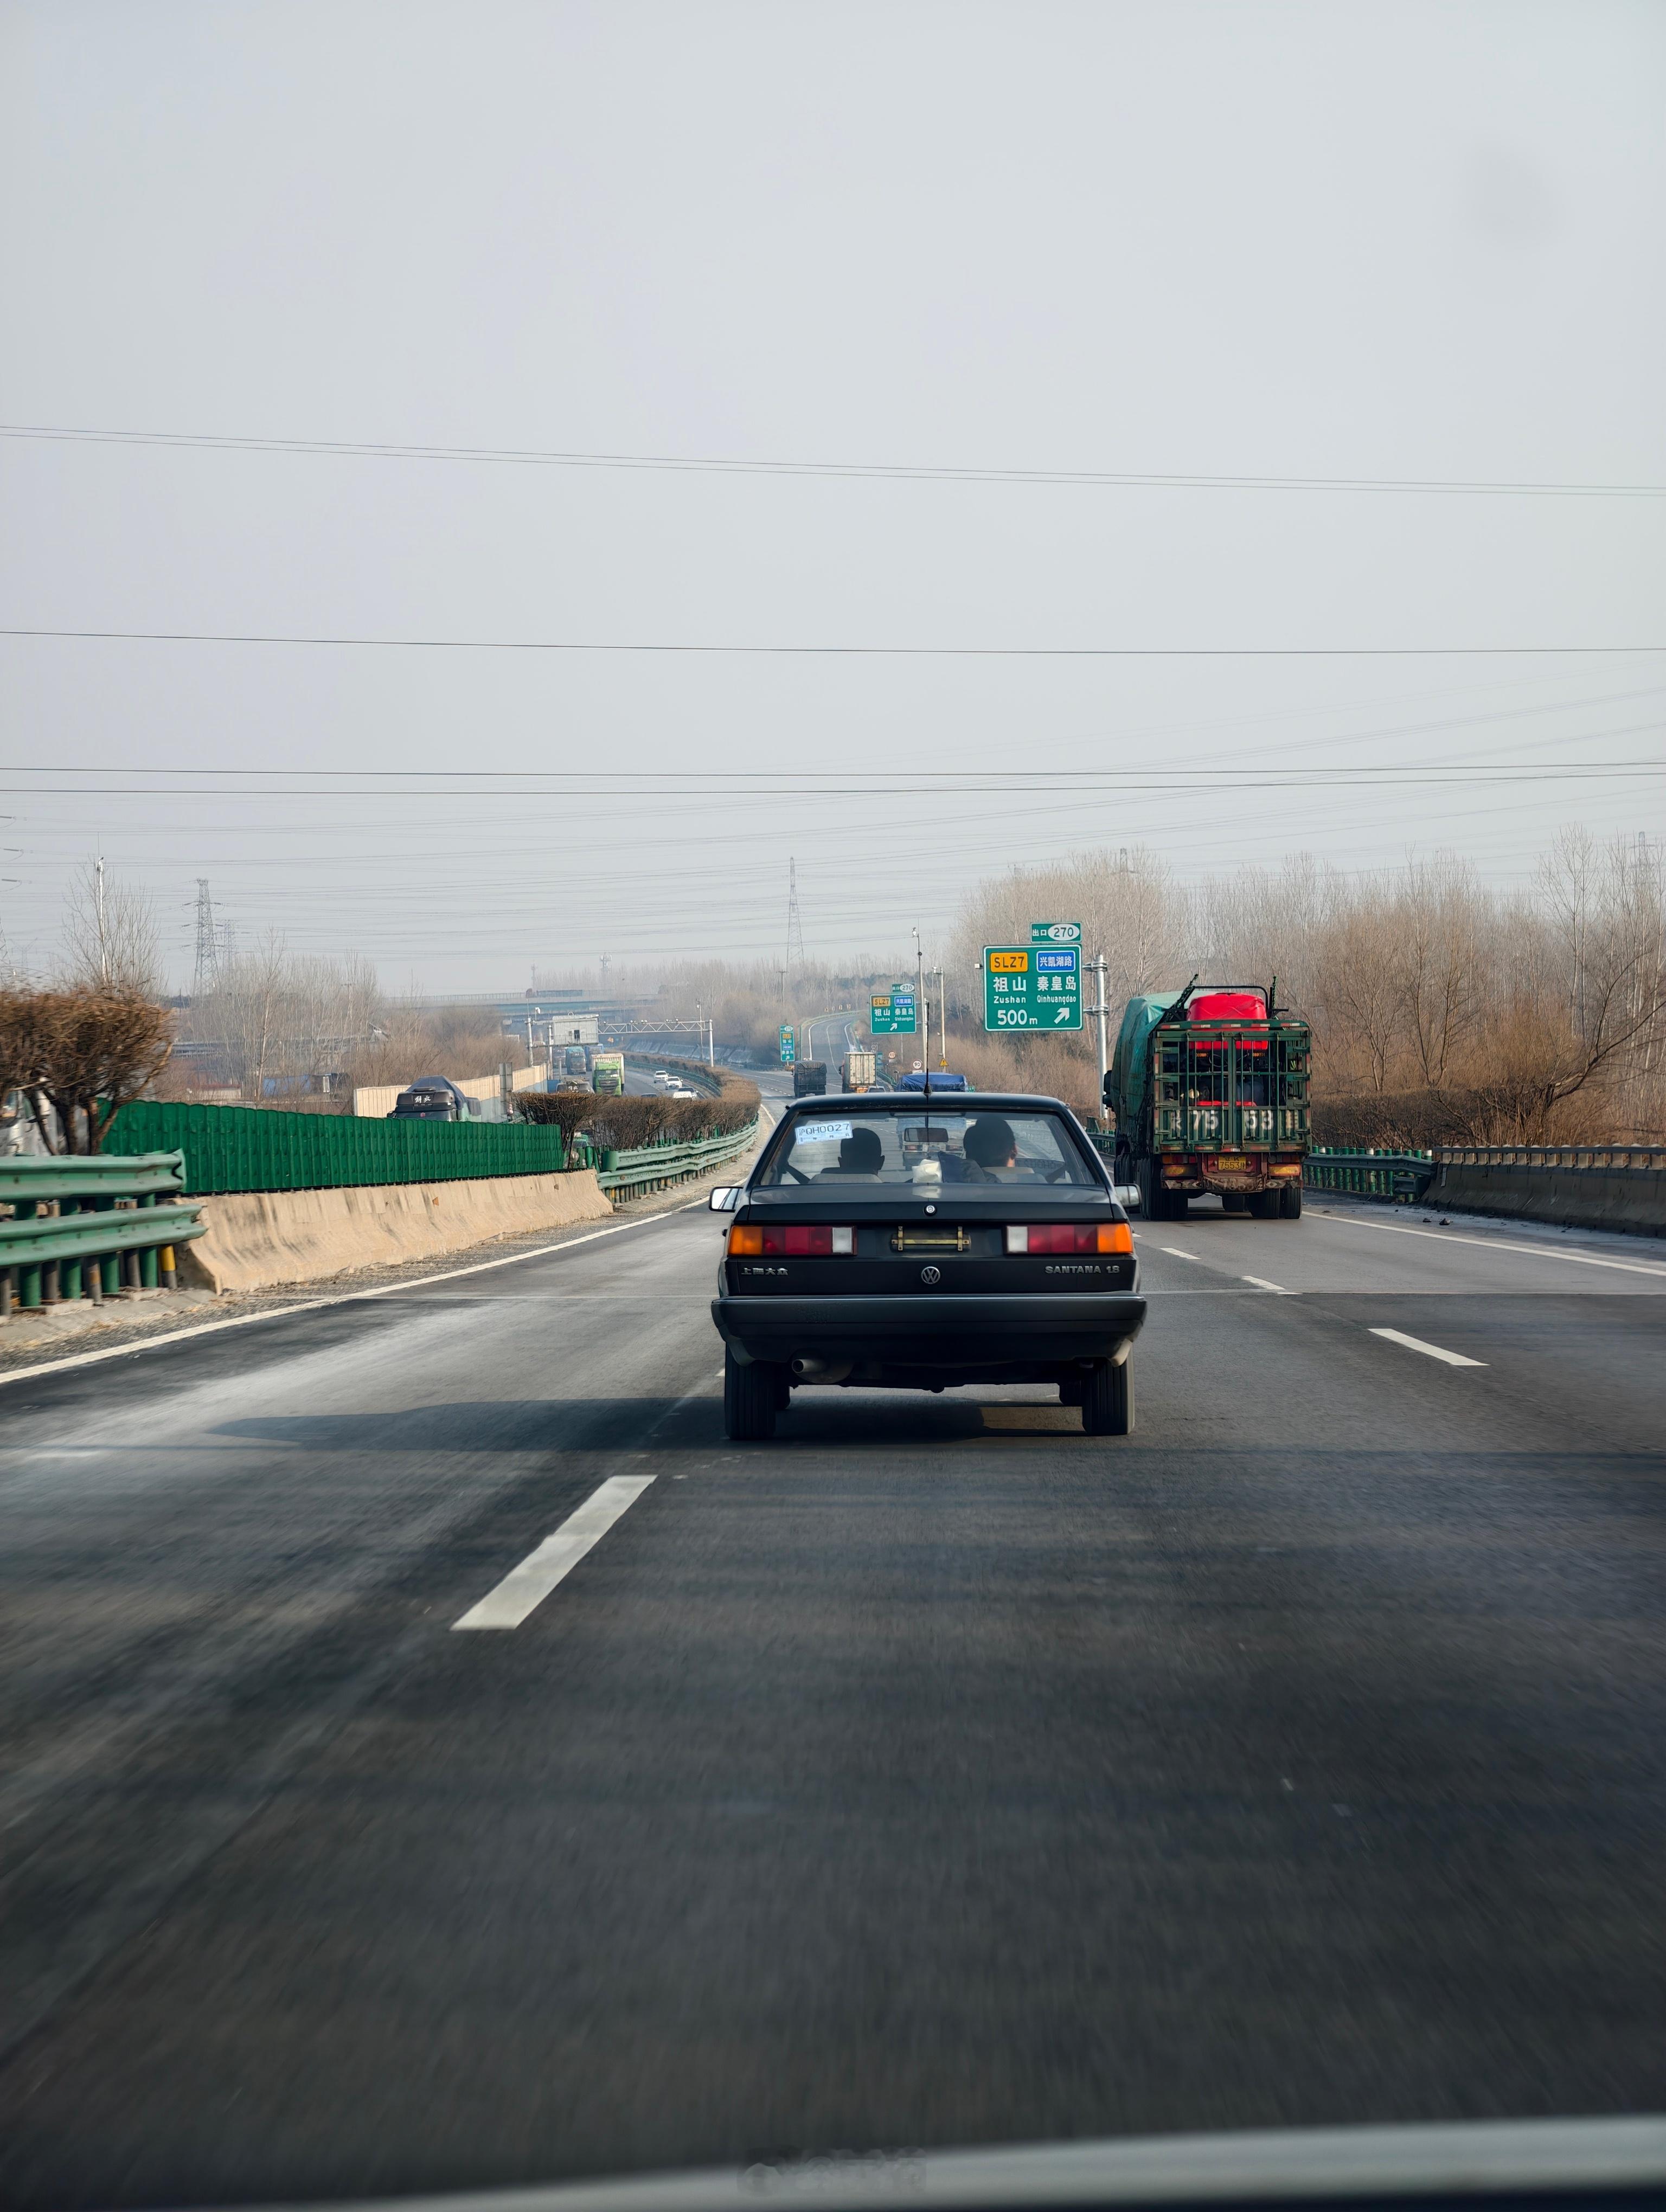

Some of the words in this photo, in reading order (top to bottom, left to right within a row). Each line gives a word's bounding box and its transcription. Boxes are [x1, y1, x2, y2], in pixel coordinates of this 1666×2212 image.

[1032, 929, 1047, 937] 出口
[1054, 928, 1074, 937] 270
[994, 956, 1024, 968] SLZ7
[1040, 956, 1072, 967] 兴凯湖路
[993, 976, 1027, 992] 祖山
[1037, 975, 1076, 991] 秦皇岛
[994, 995, 1026, 1004] Zushan
[1037, 995, 1077, 1005] Qinhuangdao
[874, 1008, 890, 1017] 祖山
[997, 1009, 1027, 1025] 500
[799, 1123, 849, 1136] 沪QH0027
